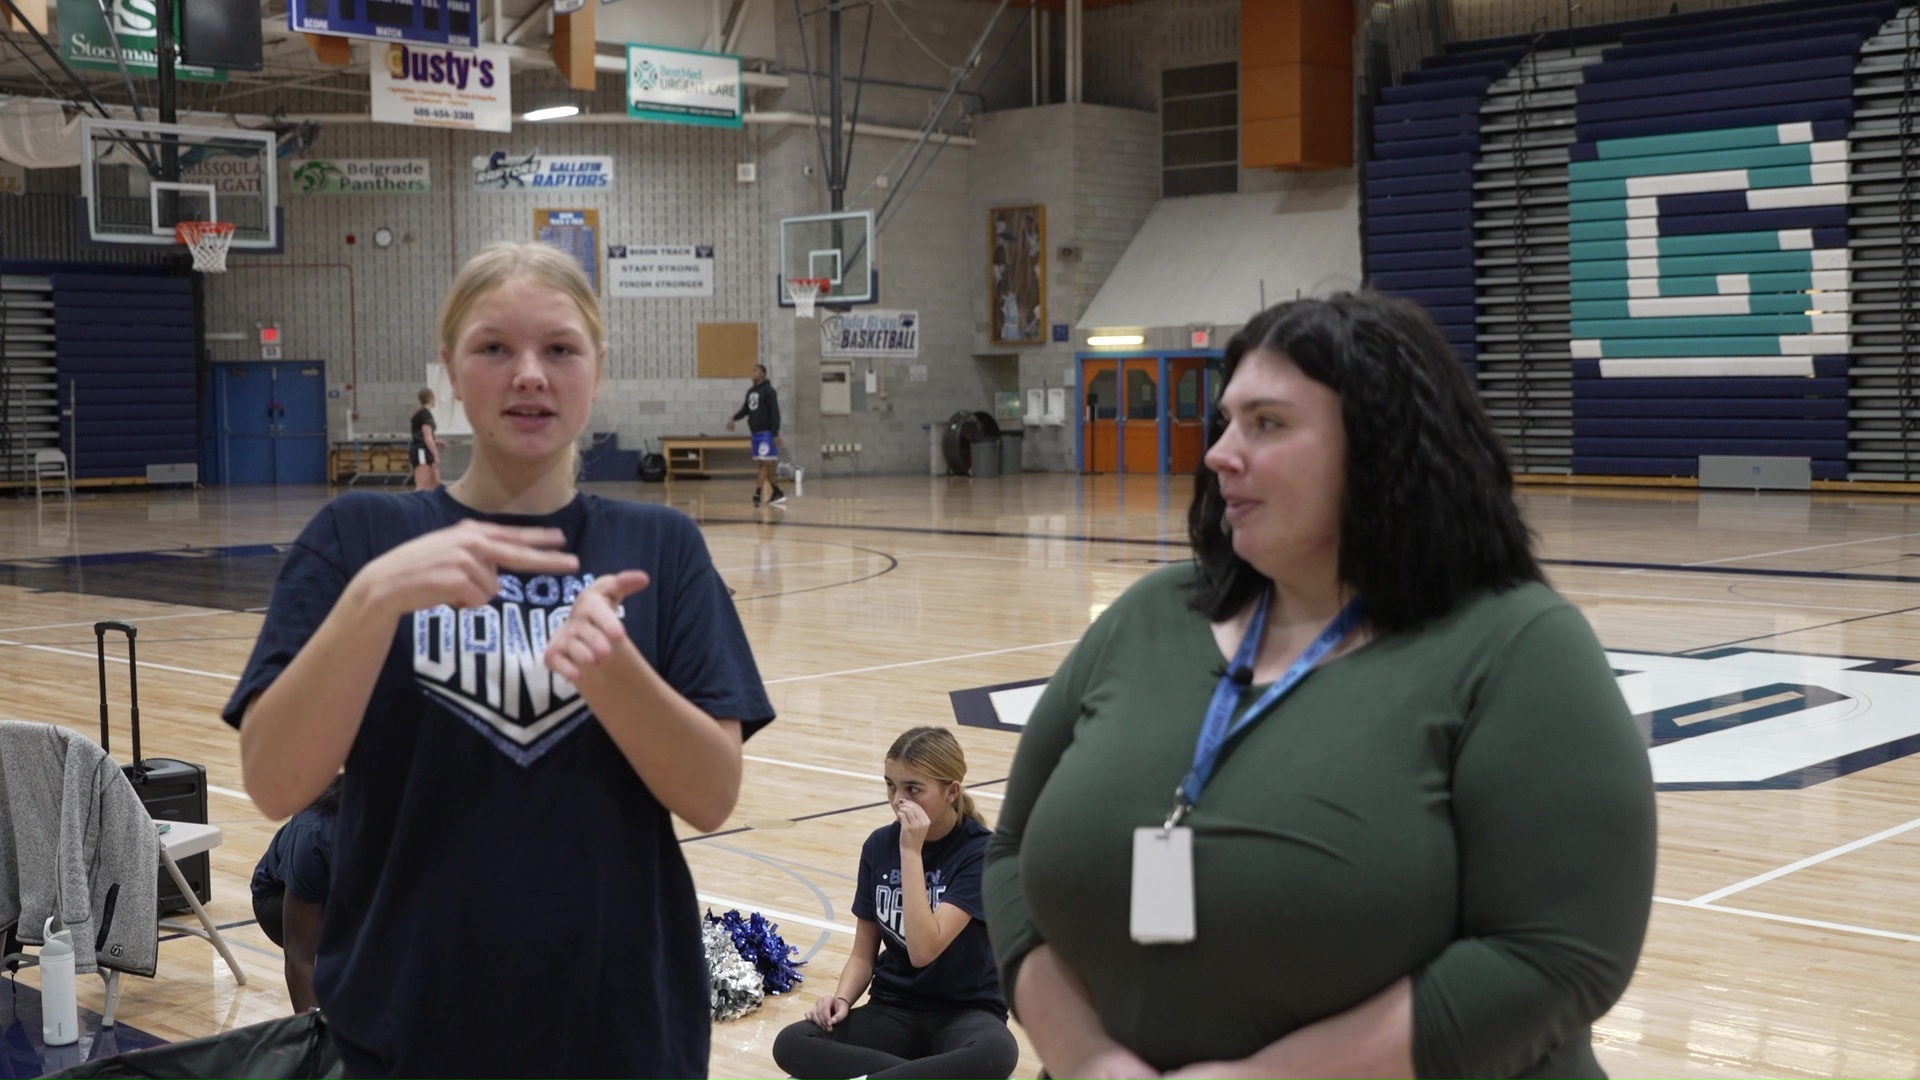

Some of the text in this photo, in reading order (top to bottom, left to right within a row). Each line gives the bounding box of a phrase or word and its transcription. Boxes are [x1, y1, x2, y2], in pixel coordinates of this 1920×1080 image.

[303, 18, 329, 30] SCORE
[375, 26, 402, 38] MATCH
[447, 34, 470, 46] SCORE
[660, 78, 736, 98] URGENT CARE
[346, 162, 424, 178] Belgrade
[549, 162, 603, 173] GALLATIN
[339, 177, 425, 192] Panthers
[532, 174, 608, 188] RAPTORS
[622, 265, 700, 273] START STRONG
[619, 281, 703, 289] FINISH STRONGER
[840, 330, 915, 349] BASKETBALL
